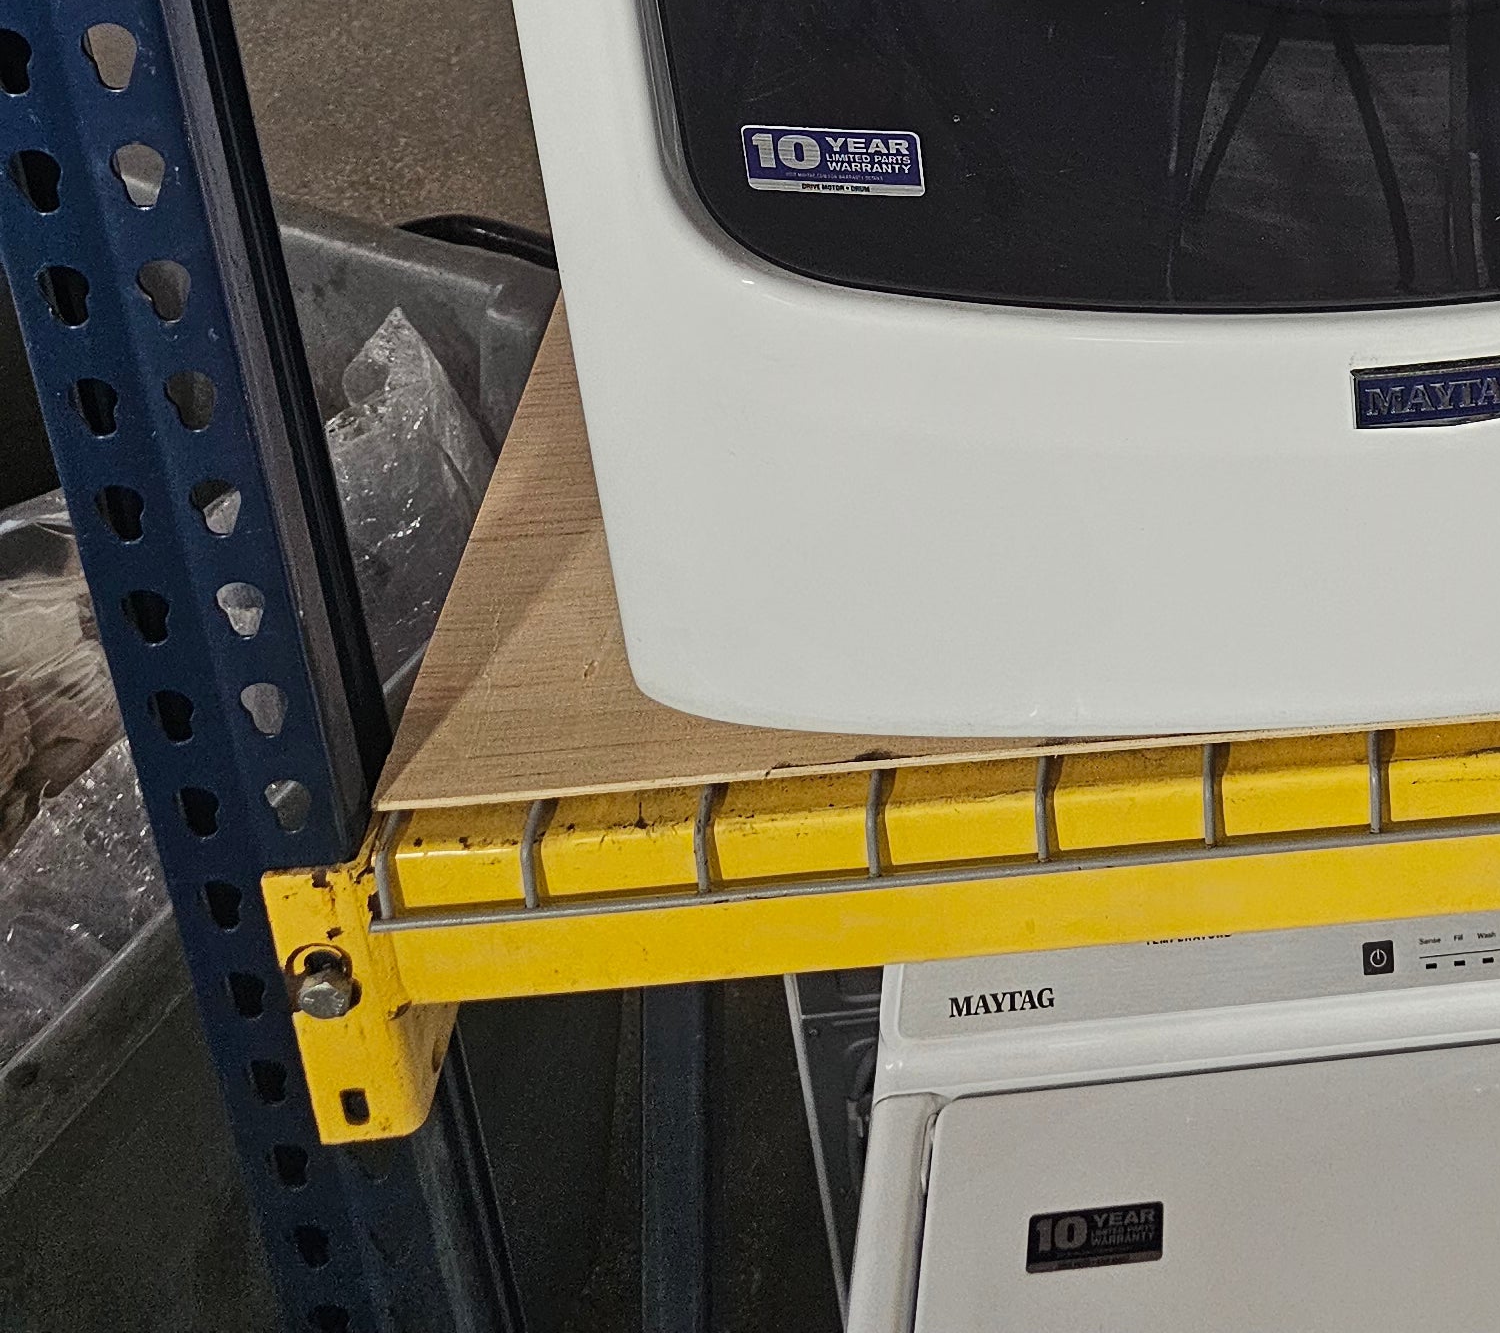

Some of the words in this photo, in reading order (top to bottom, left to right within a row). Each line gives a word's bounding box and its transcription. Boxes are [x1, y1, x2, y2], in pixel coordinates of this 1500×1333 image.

[752, 133, 821, 170] 10
[825, 136, 909, 155] YEAR
[826, 153, 872, 164] LIMITED
[874, 155, 911, 164] PARTS
[827, 162, 912, 174] WARRANTY
[822, 184, 845, 192] MOTOR
[949, 988, 1055, 1018] MAYTAG
[1093, 1208, 1155, 1228] YEAR
[1036, 1215, 1088, 1253] 10
